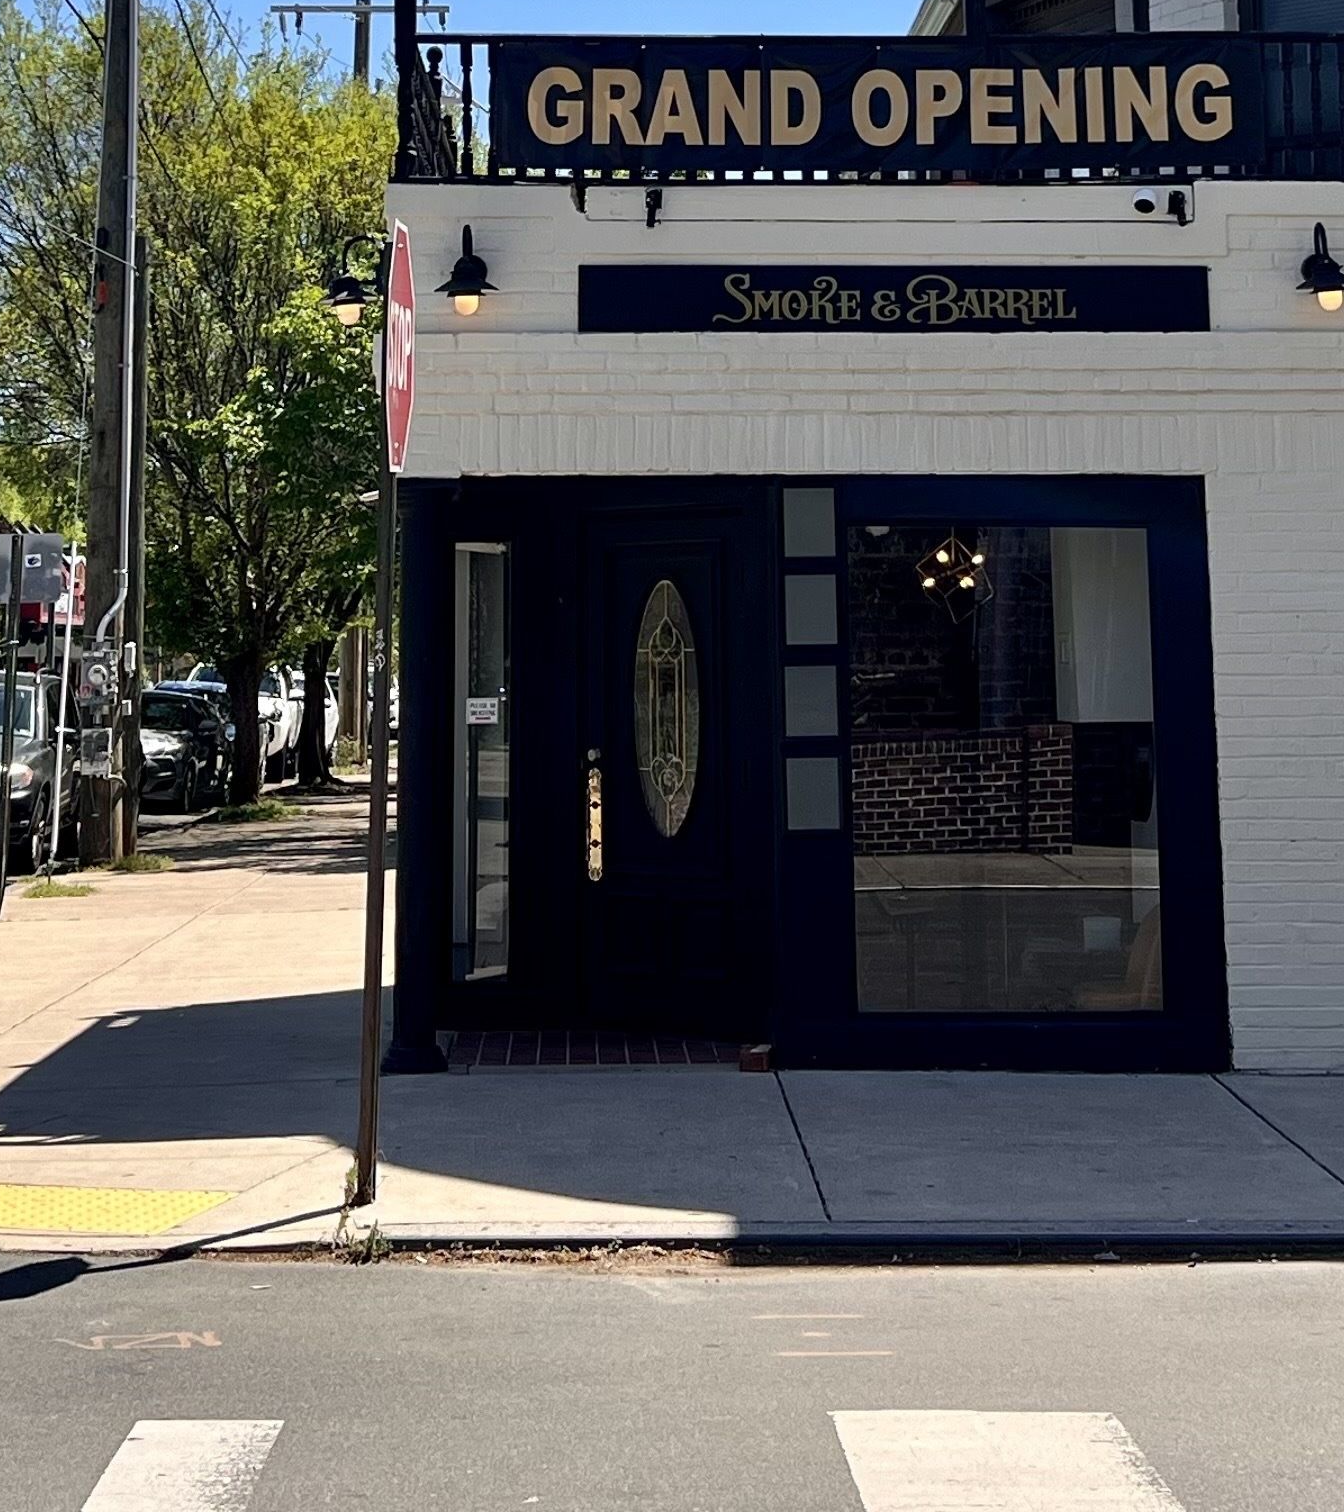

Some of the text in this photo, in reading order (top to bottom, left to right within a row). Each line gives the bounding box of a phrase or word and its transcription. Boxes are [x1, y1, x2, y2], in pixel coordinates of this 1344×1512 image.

[527, 63, 1234, 146] GRAND OPENING
[387, 300, 412, 391] STOP
[870, 290, 902, 322] &
